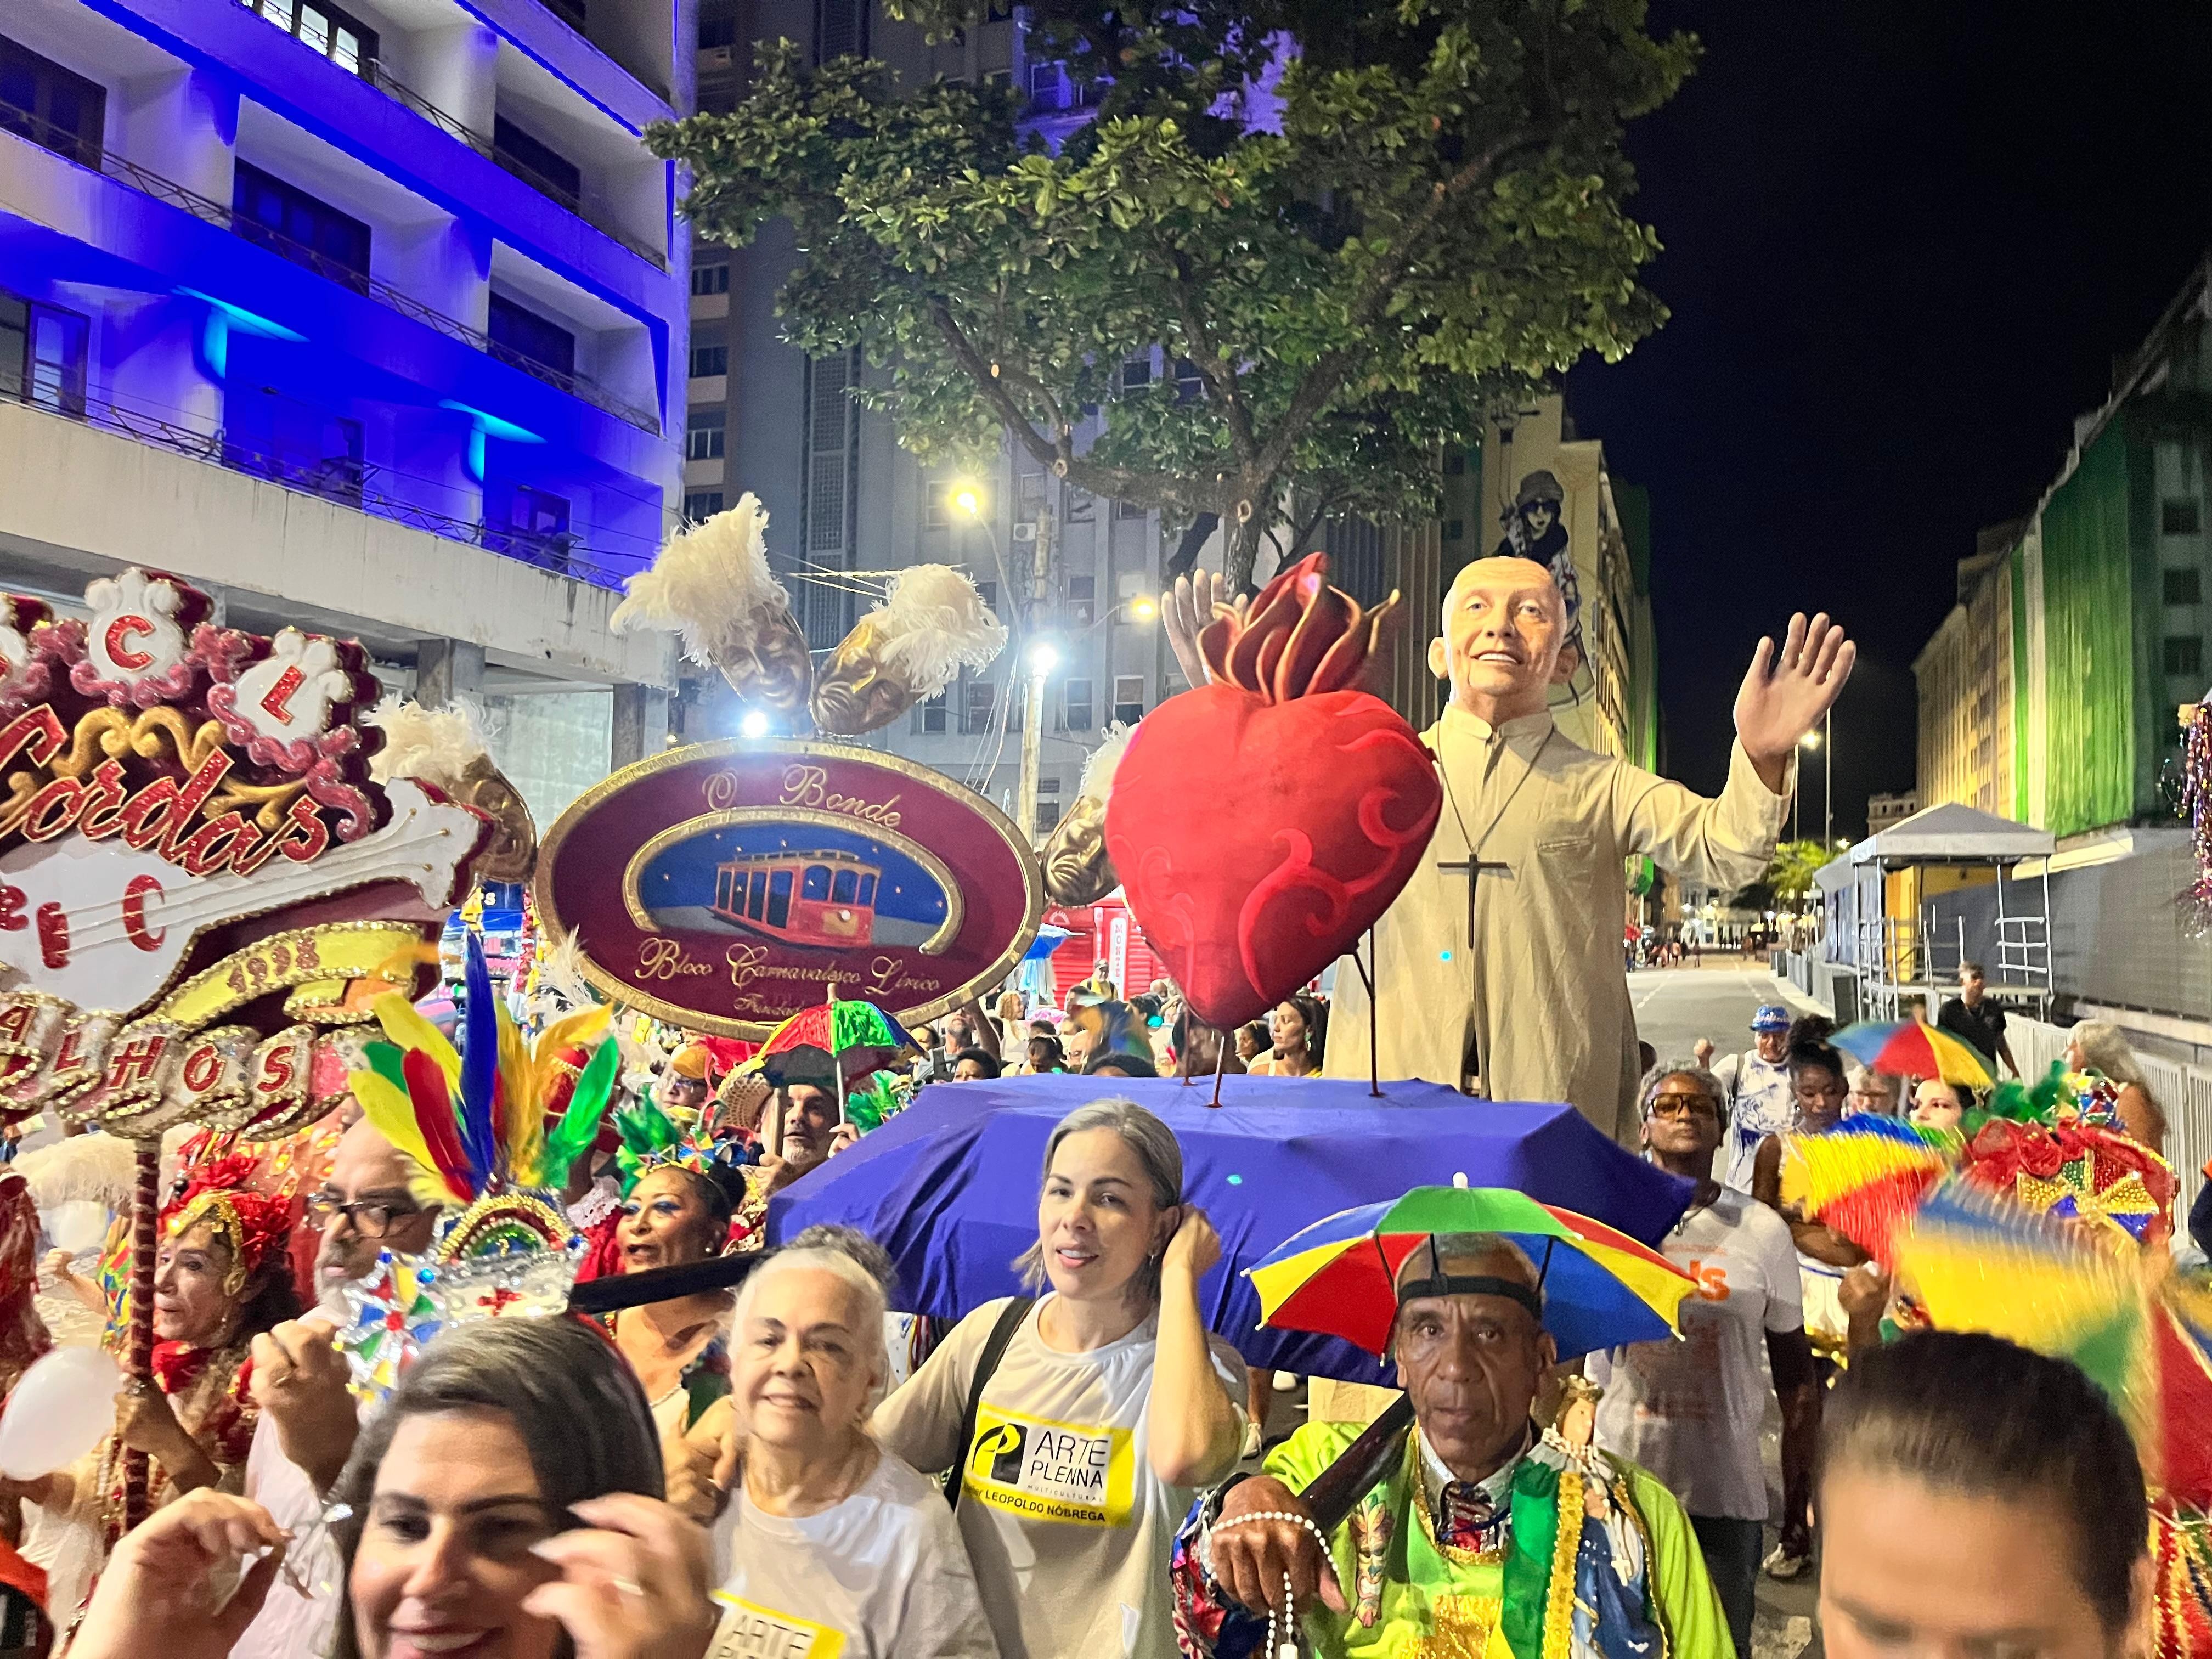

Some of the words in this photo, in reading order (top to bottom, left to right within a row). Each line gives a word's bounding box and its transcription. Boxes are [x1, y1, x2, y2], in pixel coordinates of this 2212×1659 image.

[702, 766, 737, 811] O
[779, 764, 901, 827] Bonde
[226, 936, 320, 993] 1998
[635, 937, 713, 980] Bloco
[726, 943, 861, 990] Carnavalesco
[1035, 1431, 1108, 1467] ARTE
[1027, 1485, 1103, 1502] MULTICULTURAL
[1030, 1460, 1103, 1489] PLENNA
[985, 1489, 1044, 1513] LEOPOLDO
[1047, 1504, 1105, 1522] NÓBREGA
[723, 1615, 813, 1659] ARTE
